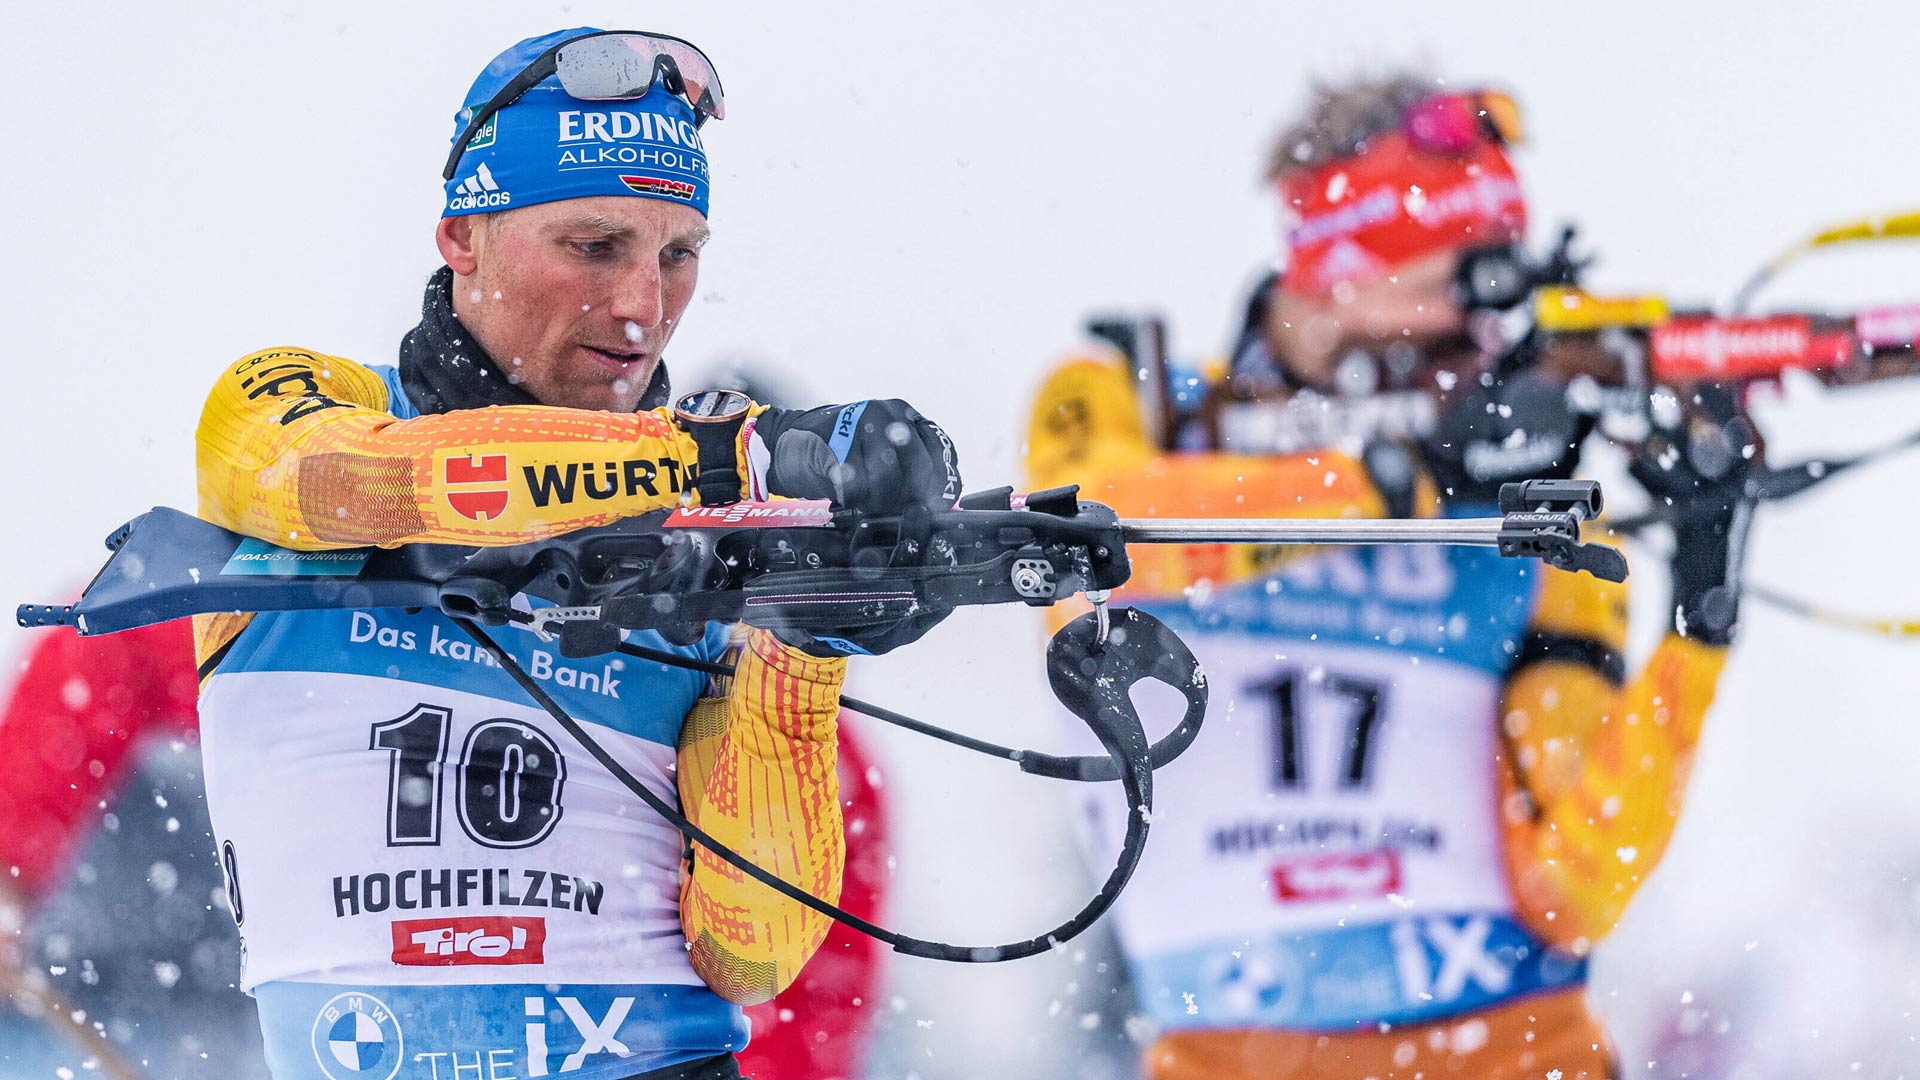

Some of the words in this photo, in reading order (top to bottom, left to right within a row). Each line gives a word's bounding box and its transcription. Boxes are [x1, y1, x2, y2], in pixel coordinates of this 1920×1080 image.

[470, 124, 494, 143] gle
[450, 190, 511, 210] adidas
[233, 552, 368, 561] #DASISTTHÜRINGEN
[350, 611, 417, 651] Das
[531, 649, 622, 699] Bank
[1240, 668, 1392, 792] 17
[368, 703, 567, 850] 10
[333, 868, 604, 918] HOCHFILZEN
[411, 926, 527, 957] Tirol
[324, 998, 388, 1024] BMW
[414, 1049, 517, 1080] THE
[525, 996, 636, 1078] iX
